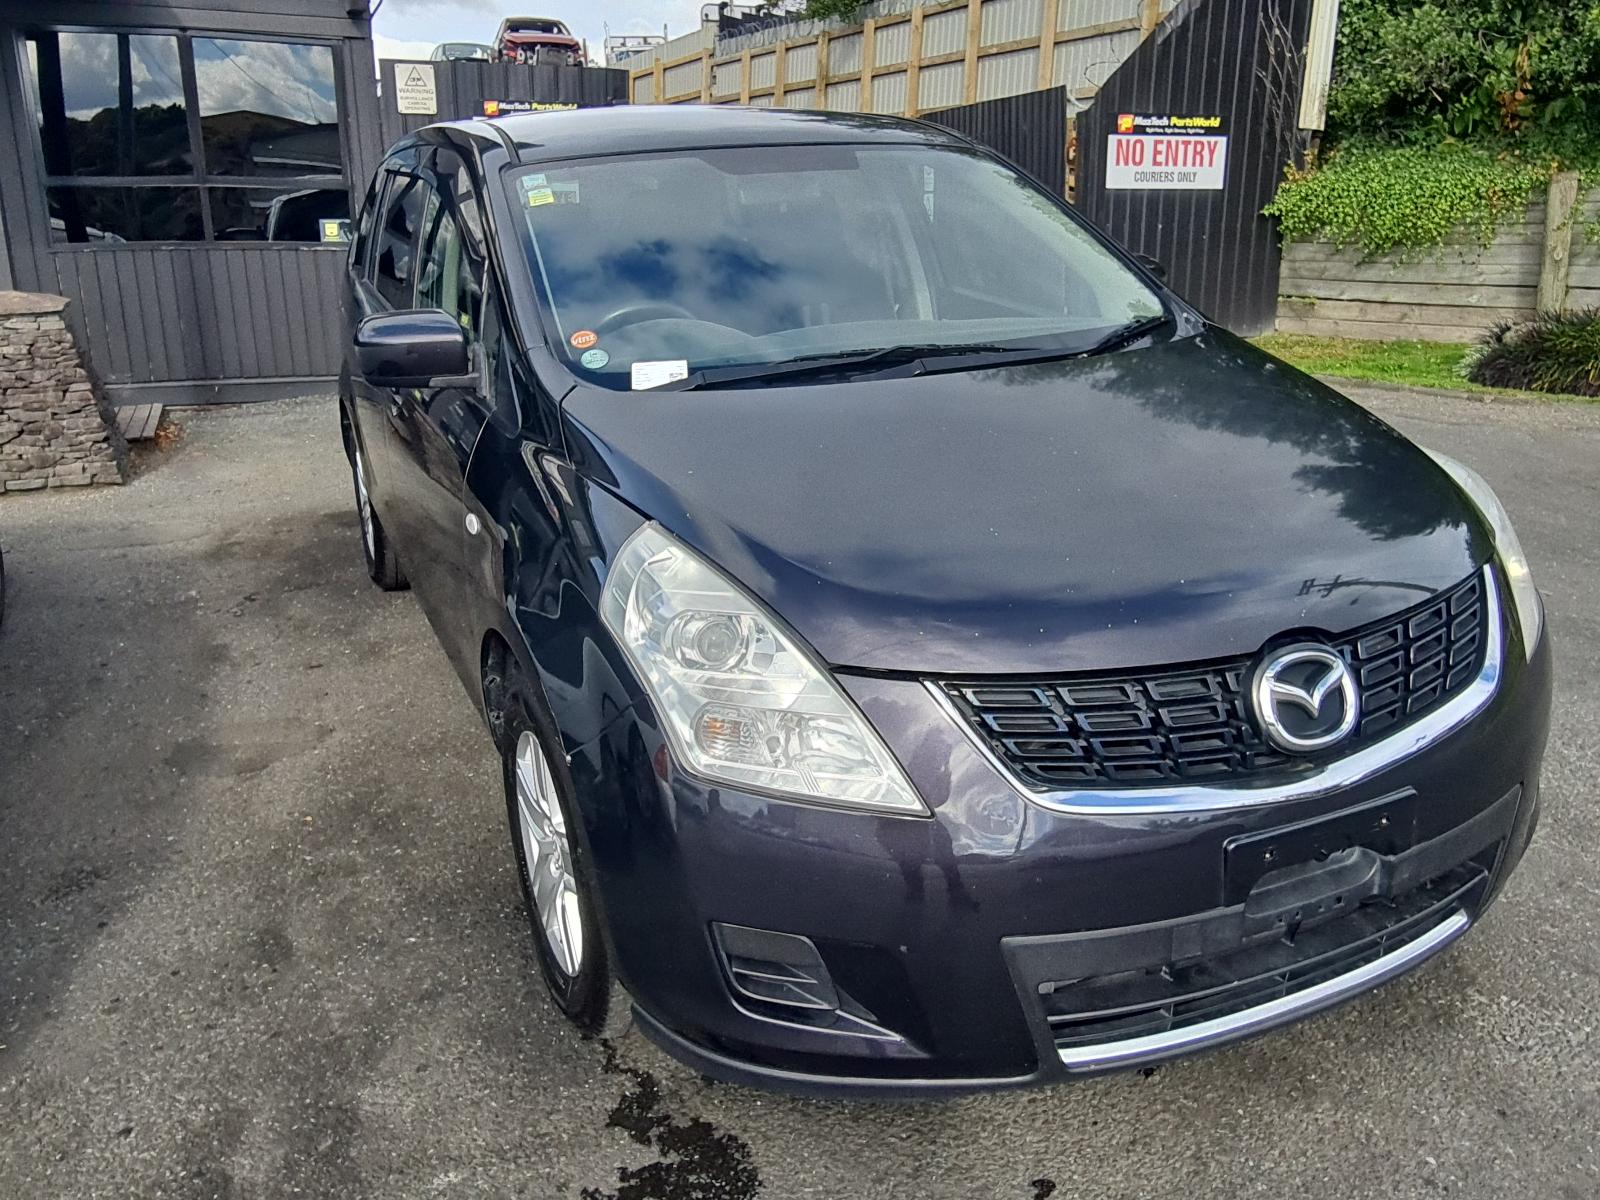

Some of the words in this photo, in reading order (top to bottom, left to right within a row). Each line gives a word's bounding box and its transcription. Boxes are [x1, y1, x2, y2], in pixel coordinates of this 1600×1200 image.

[398, 87, 434, 95] WARNING
[1115, 138, 1145, 167] NO
[1152, 139, 1218, 168] ENTRY
[1134, 171, 1175, 183] COURIERS
[1177, 171, 1197, 183] ONLY
